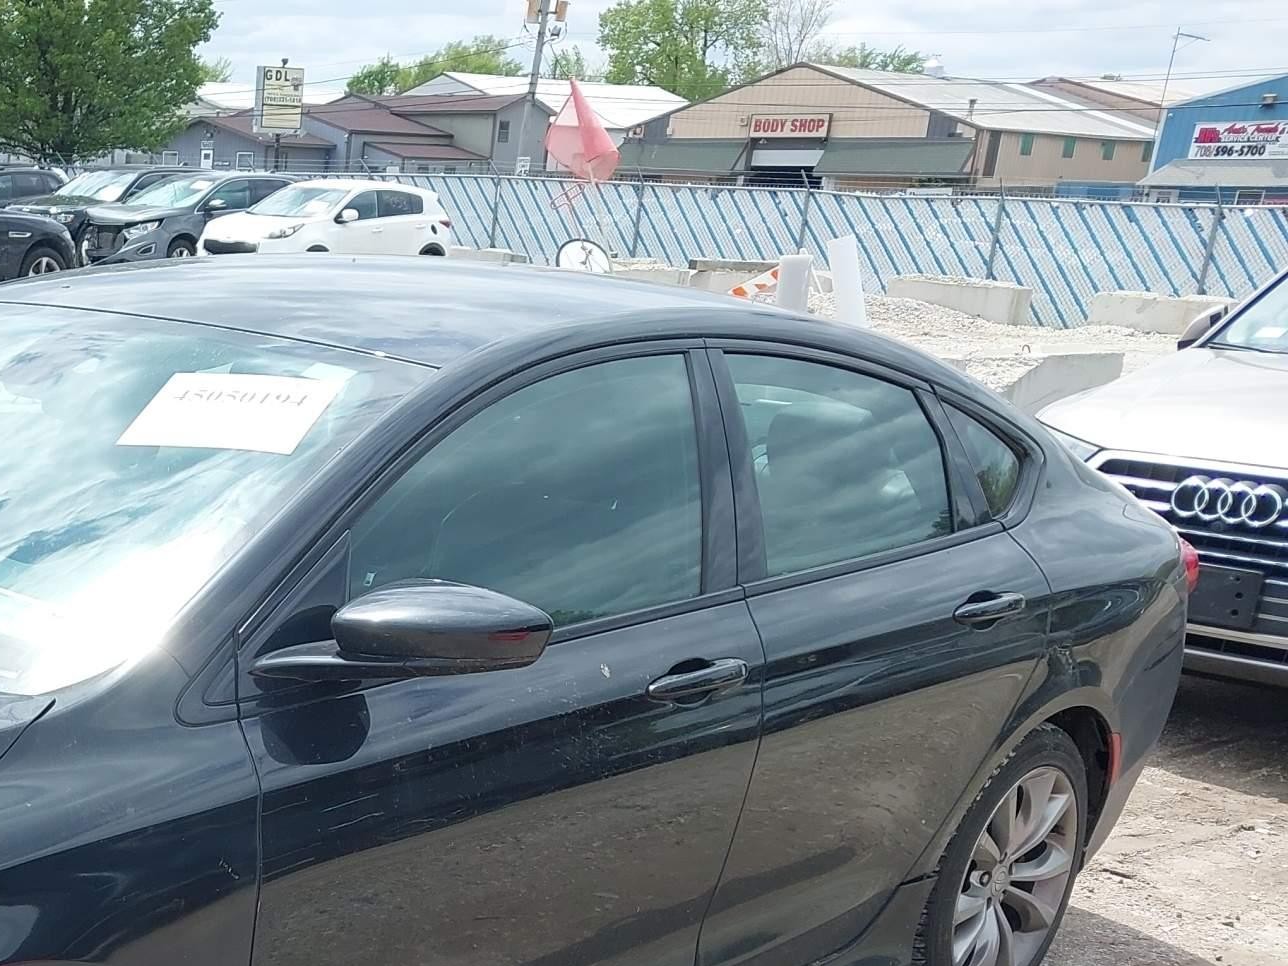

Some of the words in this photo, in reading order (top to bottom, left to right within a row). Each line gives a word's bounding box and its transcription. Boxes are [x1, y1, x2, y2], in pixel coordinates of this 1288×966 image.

[265, 69, 290, 82] GDL
[753, 118, 788, 133] BODY
[790, 118, 825, 133] SHOP
